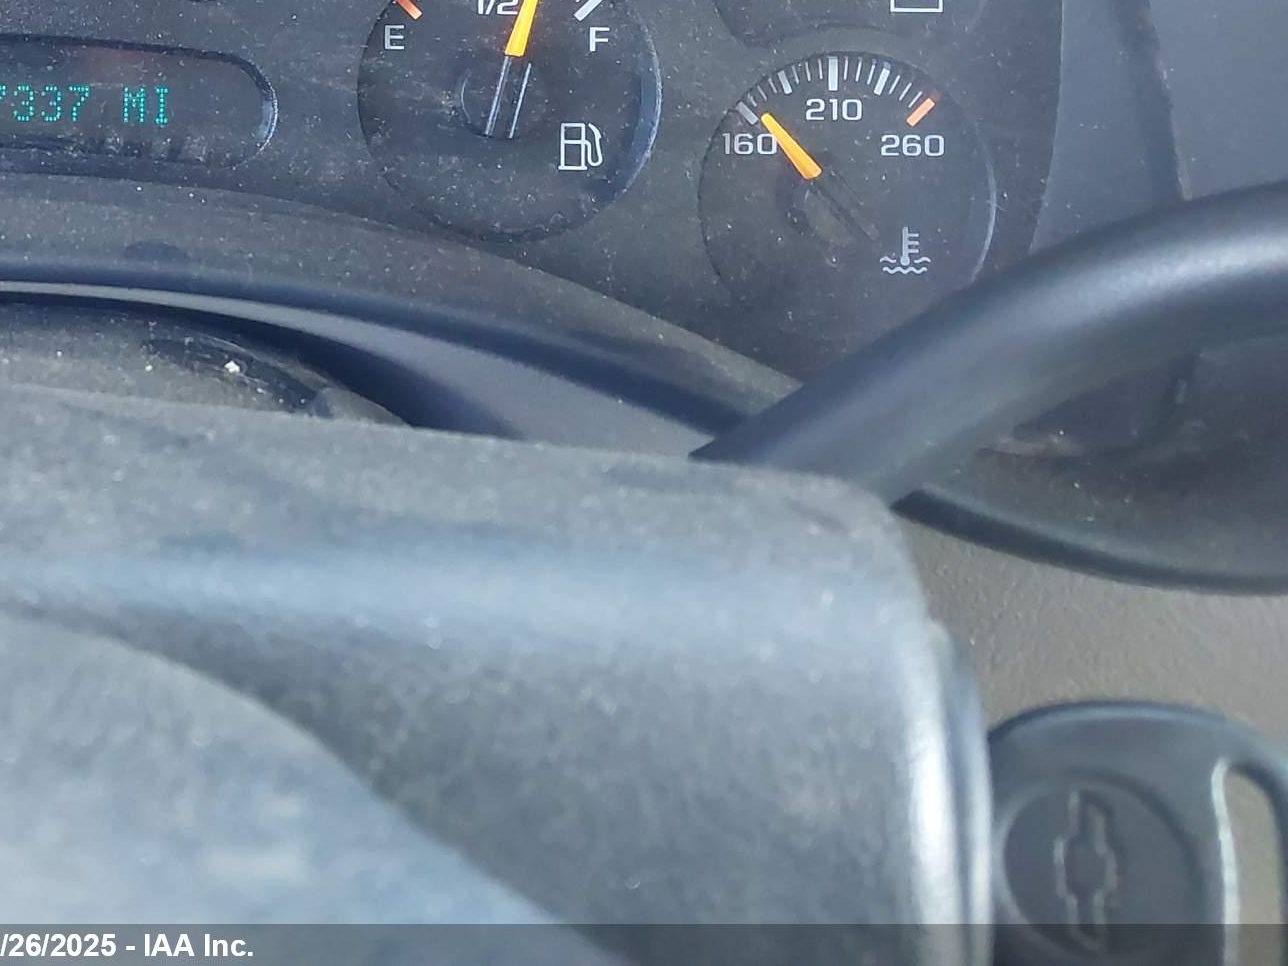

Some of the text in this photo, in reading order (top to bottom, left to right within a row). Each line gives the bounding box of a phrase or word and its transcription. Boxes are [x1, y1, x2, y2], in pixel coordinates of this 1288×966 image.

[384, 24, 405, 50] E
[589, 26, 610, 52] F
[123, 86, 170, 126] MI
[805, 98, 863, 121] 210
[722, 133, 778, 155] 160
[880, 134, 945, 157] 260
